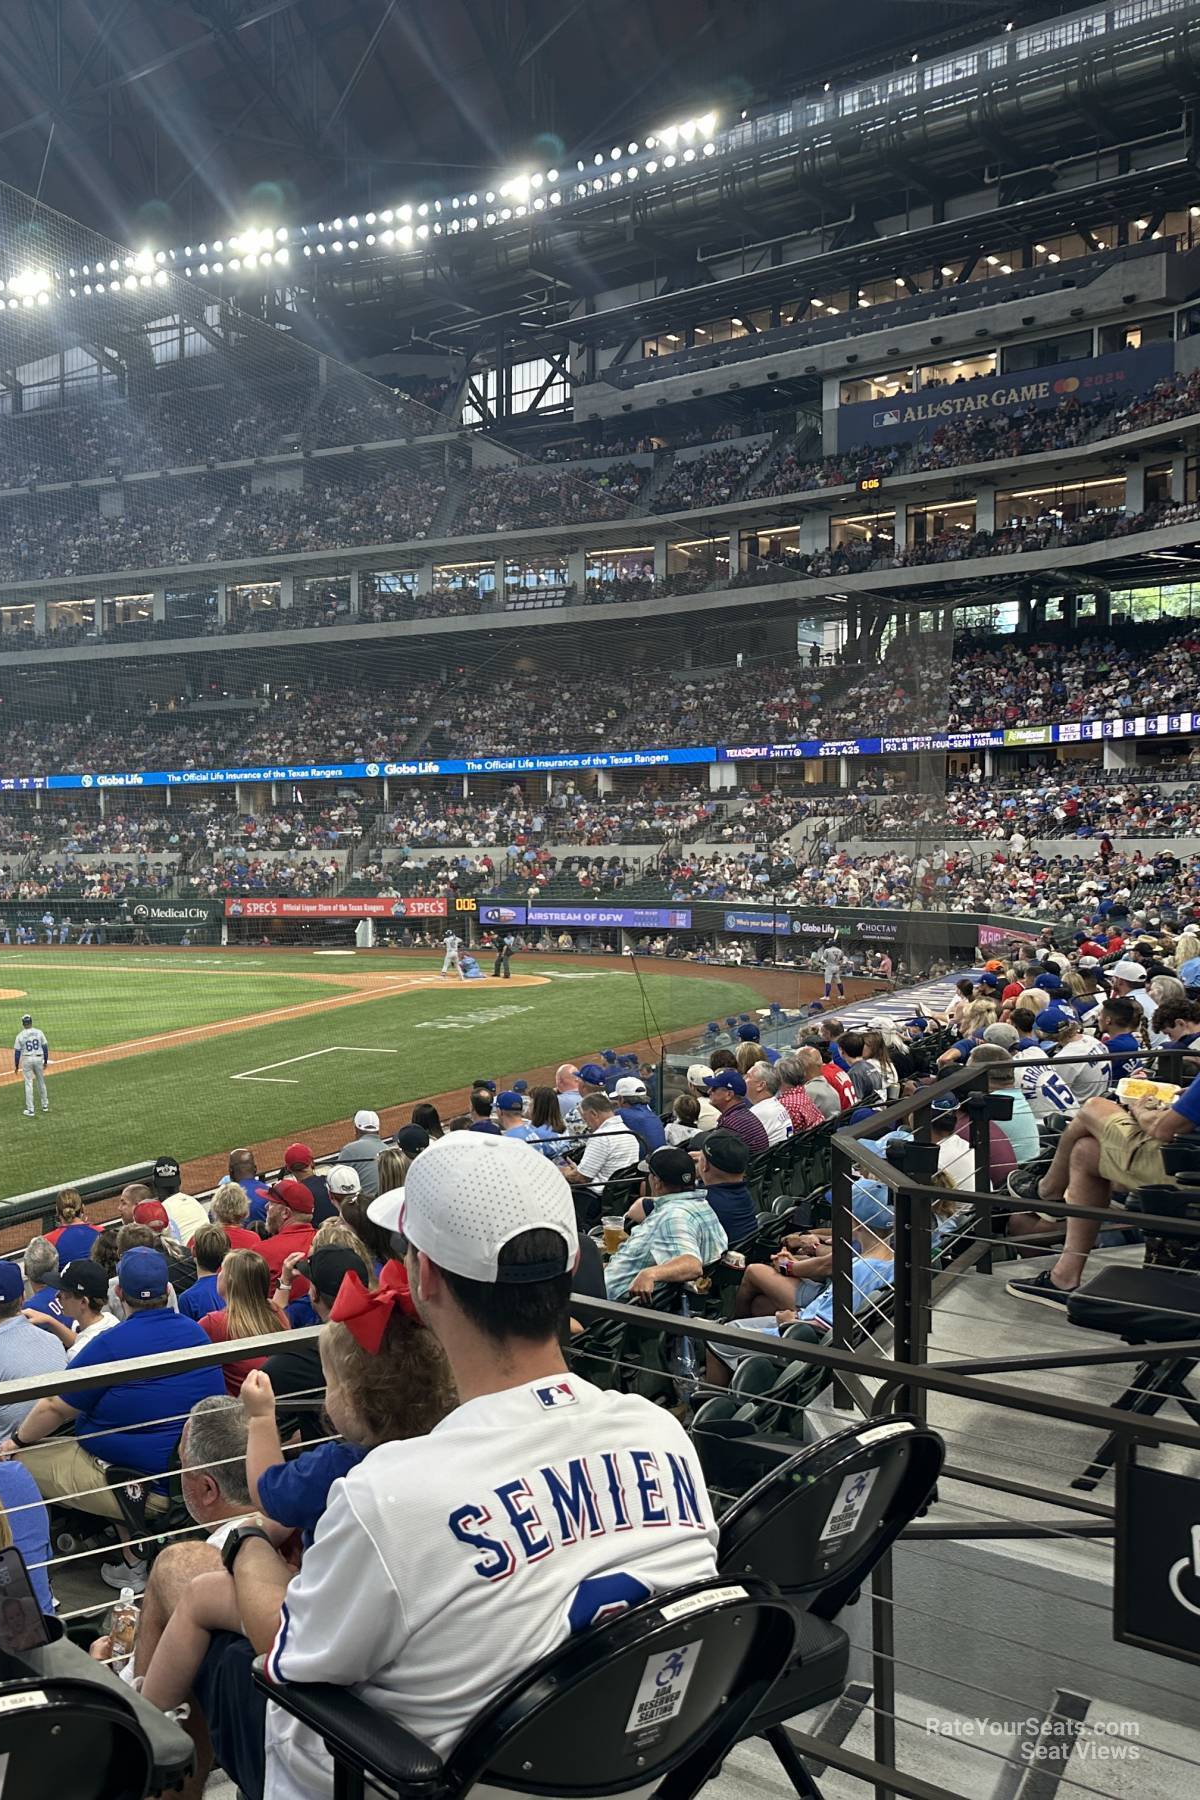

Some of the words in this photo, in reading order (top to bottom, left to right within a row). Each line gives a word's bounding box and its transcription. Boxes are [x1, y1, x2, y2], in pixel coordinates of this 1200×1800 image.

[990, 382, 1050, 408] GAME
[1083, 371, 1127, 389] 2024
[1085, 727, 1092, 735] 1
[1105, 725, 1112, 733] 2
[1127, 723, 1134, 732] 3
[1148, 721, 1156, 730] 4
[1172, 719, 1180, 728] 5
[885, 741, 908, 752] 93.8
[973, 736, 1004, 748] FASTBALL
[726, 747, 748, 758] TEXAS
[818, 745, 860, 757] $12,425
[384, 763, 418, 776] Globe
[418, 762, 440, 774] Life
[465, 761, 483, 771] The
[484, 760, 516, 771] Official
[517, 759, 535, 769] Life
[536, 758, 580, 769] Insurance
[580, 758, 592, 767] of
[592, 756, 608, 765] the
[609, 755, 633, 765] Texas
[634, 753, 670, 766] Rangers
[96, 774, 125, 786] Globe
[125, 773, 144, 785] Life
[167, 774, 181, 783] The
[182, 773, 210, 783] Official
[210, 771, 224, 781] Life
[225, 771, 262, 781] Insurance
[262, 770, 273, 779] of
[273, 769, 286, 778] the
[287, 769, 309, 778] Texas
[310, 767, 343, 779] Rangers
[246, 900, 277, 913] SPEC'S
[410, 901, 444, 913] SPEC'S
[455, 898, 477, 911] 006
[150, 907, 188, 919] Medical
[188, 907, 209, 921] City
[527, 912, 582, 922] AIRSTREAM
[583, 912, 599, 921] OF
[599, 913, 624, 922] DFW
[801, 922, 822, 933] Globe
[822, 922, 835, 934] Life
[860, 923, 897, 933] CHOCTAW
[25, 1038, 40, 1052] 68
[1041, 1073, 1075, 1112] 15
[448, 1449, 706, 1583] SEMIEN
[653, 1684, 673, 1699] ADA
[637, 1690, 682, 1713] RESERVED
[638, 1701, 675, 1722] SEATING
